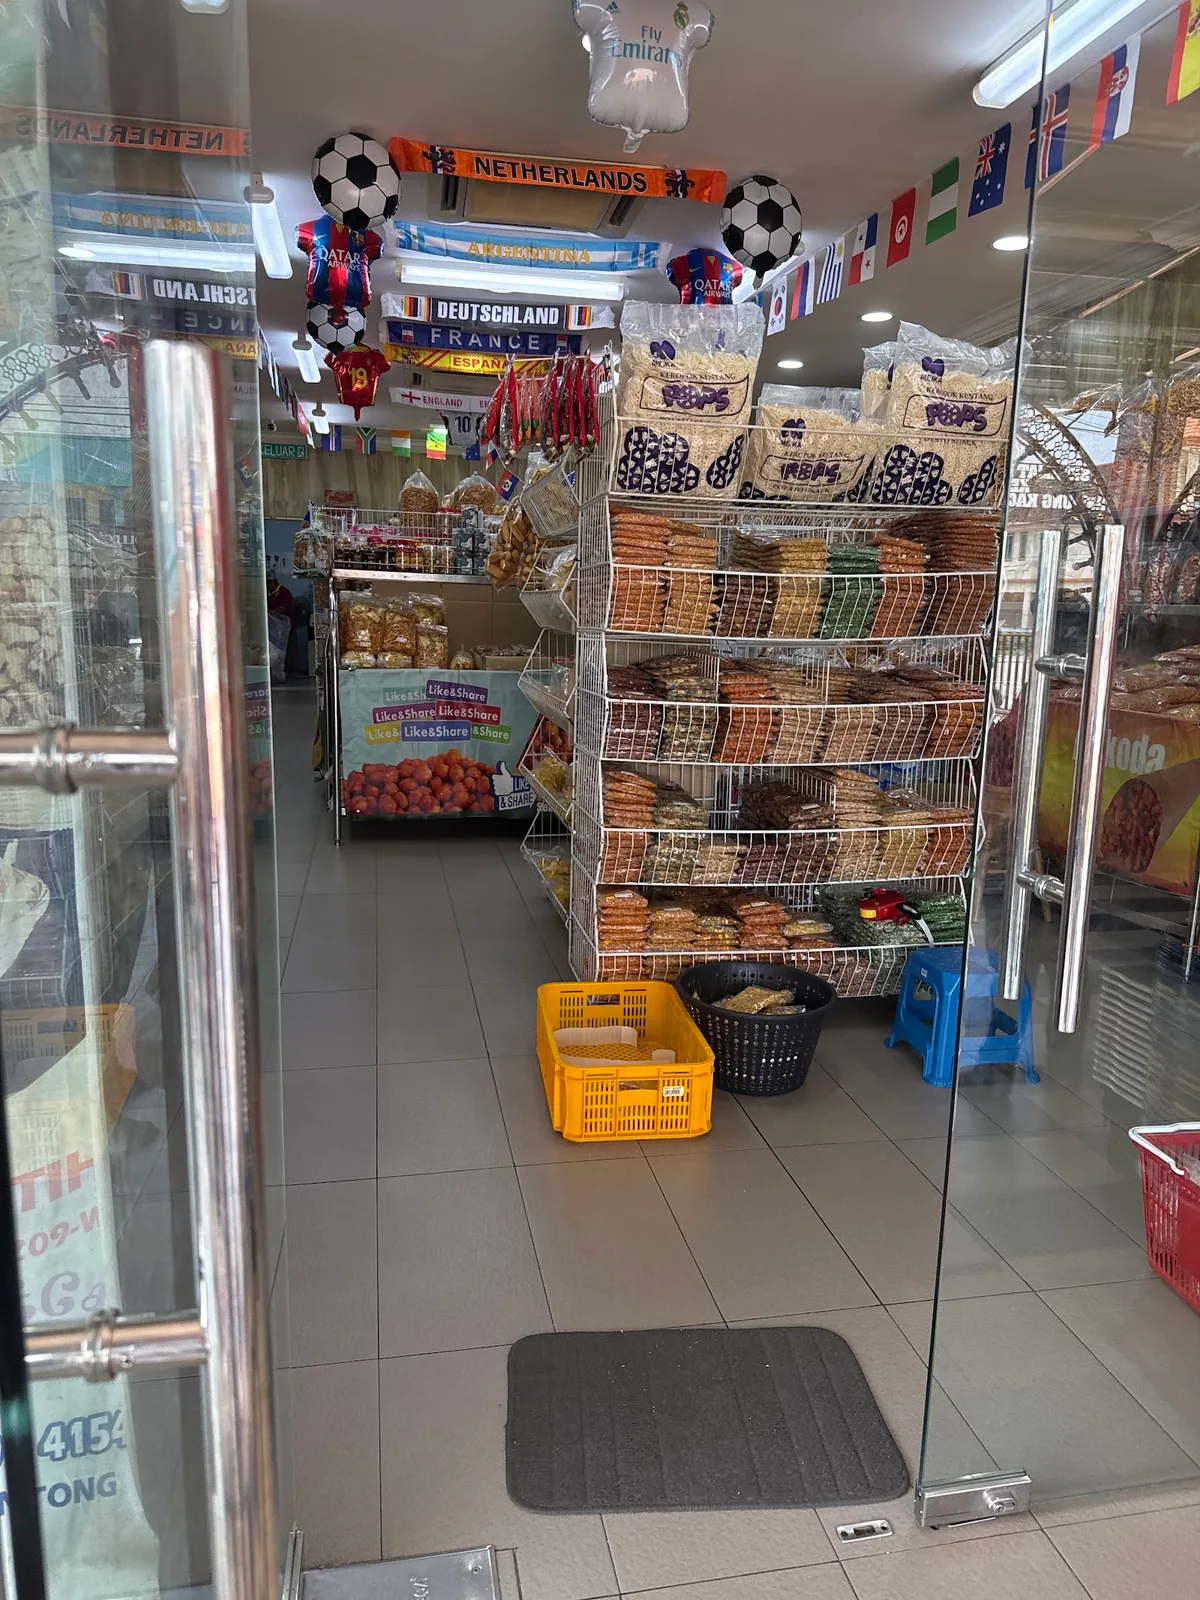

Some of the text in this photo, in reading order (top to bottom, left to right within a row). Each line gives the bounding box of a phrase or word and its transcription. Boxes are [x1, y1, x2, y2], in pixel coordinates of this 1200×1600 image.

[641, 25, 662, 43] Fly
[474, 156, 648, 193] NETHERLANDS
[319, 248, 361, 264] QATAR
[466, 240, 592, 265] ARGENTINA
[327, 260, 361, 272] AIRWAYS
[694, 278, 732, 292] QATAR
[703, 289, 732, 299] AIRWAYS
[437, 301, 559, 325] DEUTSCHLAND
[431, 327, 540, 351] FRANCE
[423, 395, 463, 407] ENGLAND
[662, 384, 730, 412] POPS
[455, 415, 472, 433] 10
[926, 403, 988, 431] POPS
[780, 462, 841, 482] POPS
[386, 691, 429, 702] Like&Sh
[428, 685, 486, 702] Like&Share
[376, 707, 436, 723] Like&Share
[439, 705, 499, 721] Like&Share
[404, 725, 469, 738] Like&Share
[514, 778, 530, 792] LIKE
[508, 791, 534, 808] SHARE
